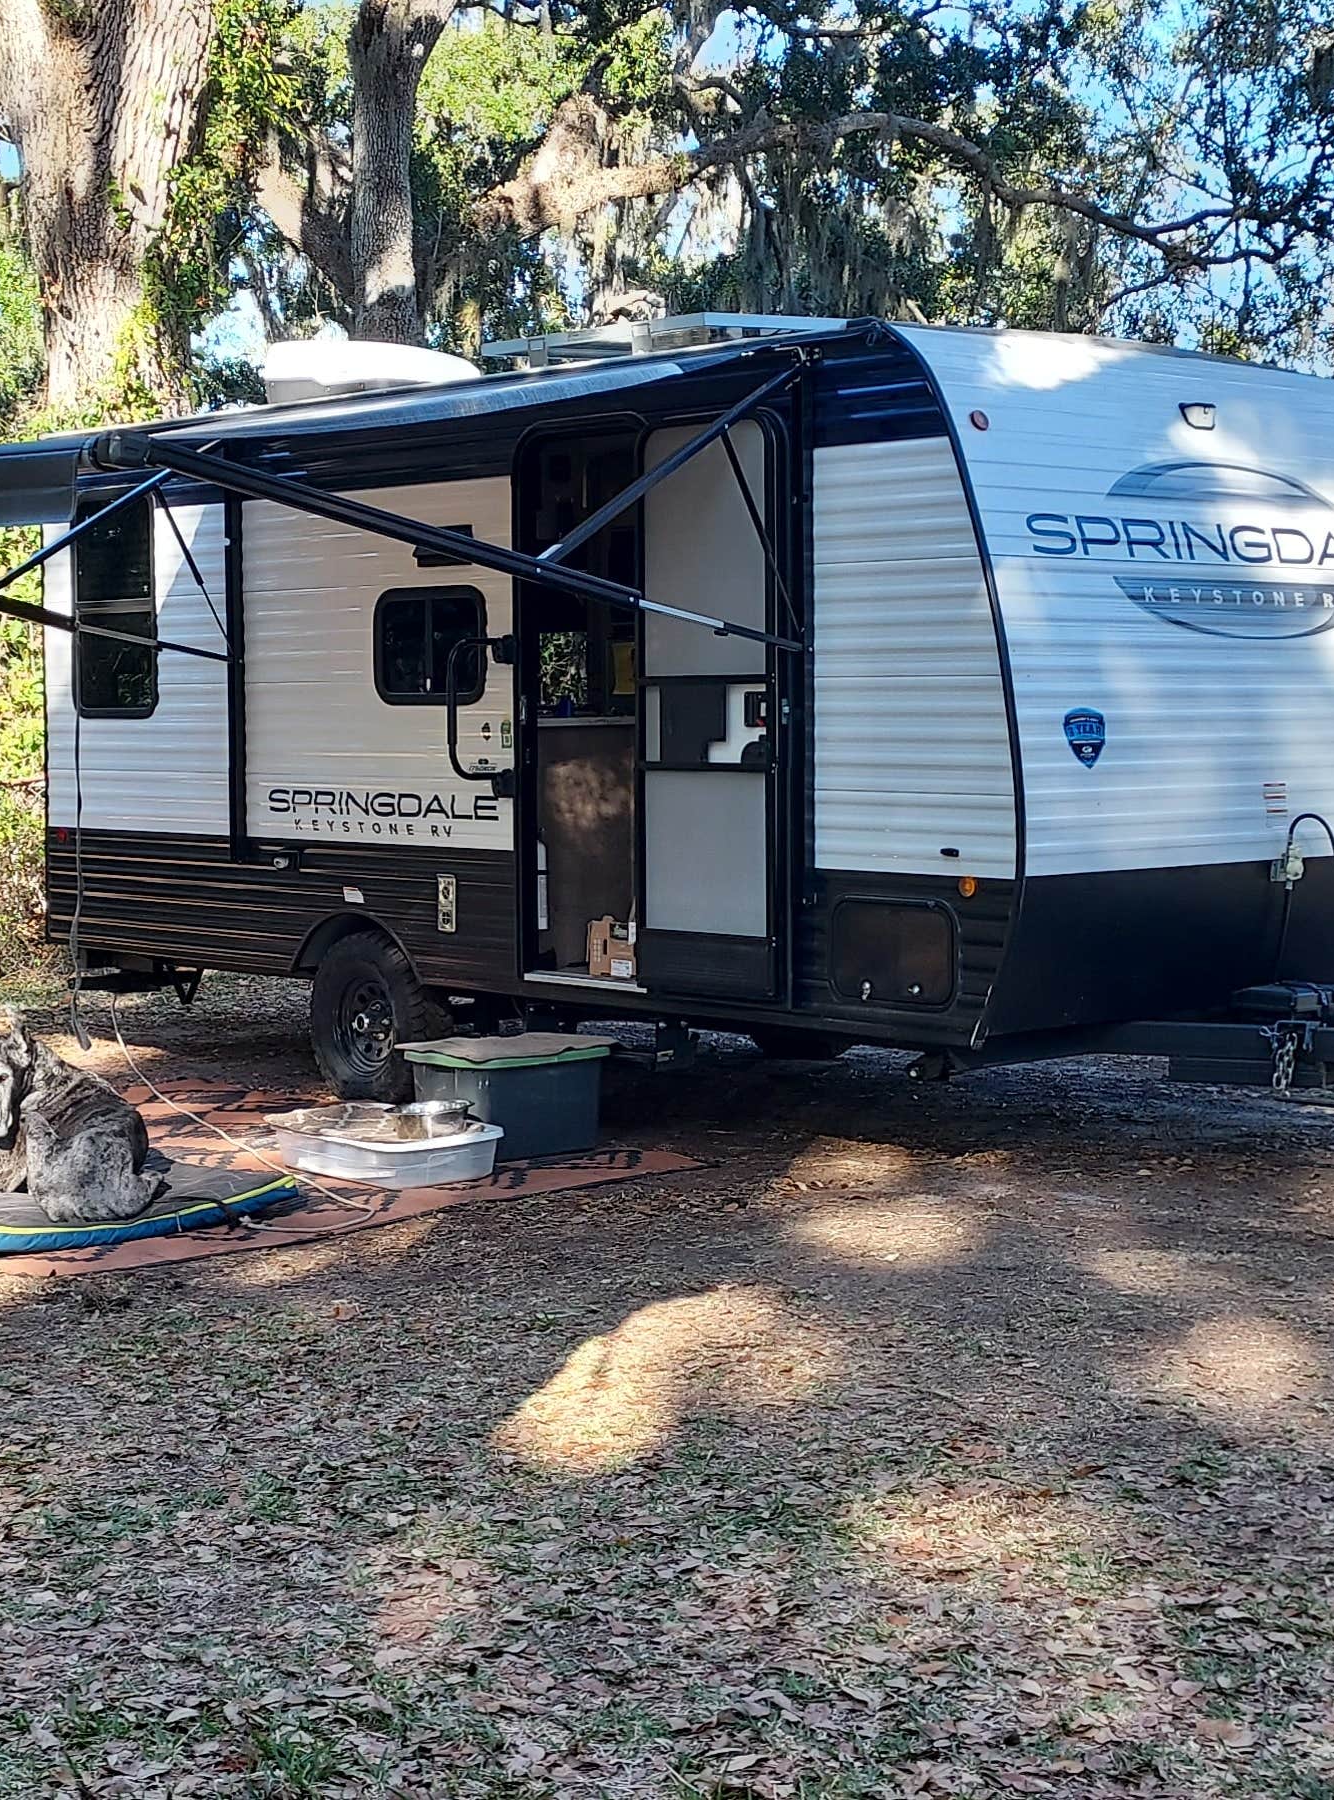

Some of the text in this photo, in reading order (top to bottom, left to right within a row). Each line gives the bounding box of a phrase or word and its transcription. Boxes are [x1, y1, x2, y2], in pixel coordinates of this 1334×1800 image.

[1143, 585, 1306, 608] KEYSTONE
[268, 788, 500, 821] SPRINGDALE
[294, 818, 453, 838] KEYSTONE RV
